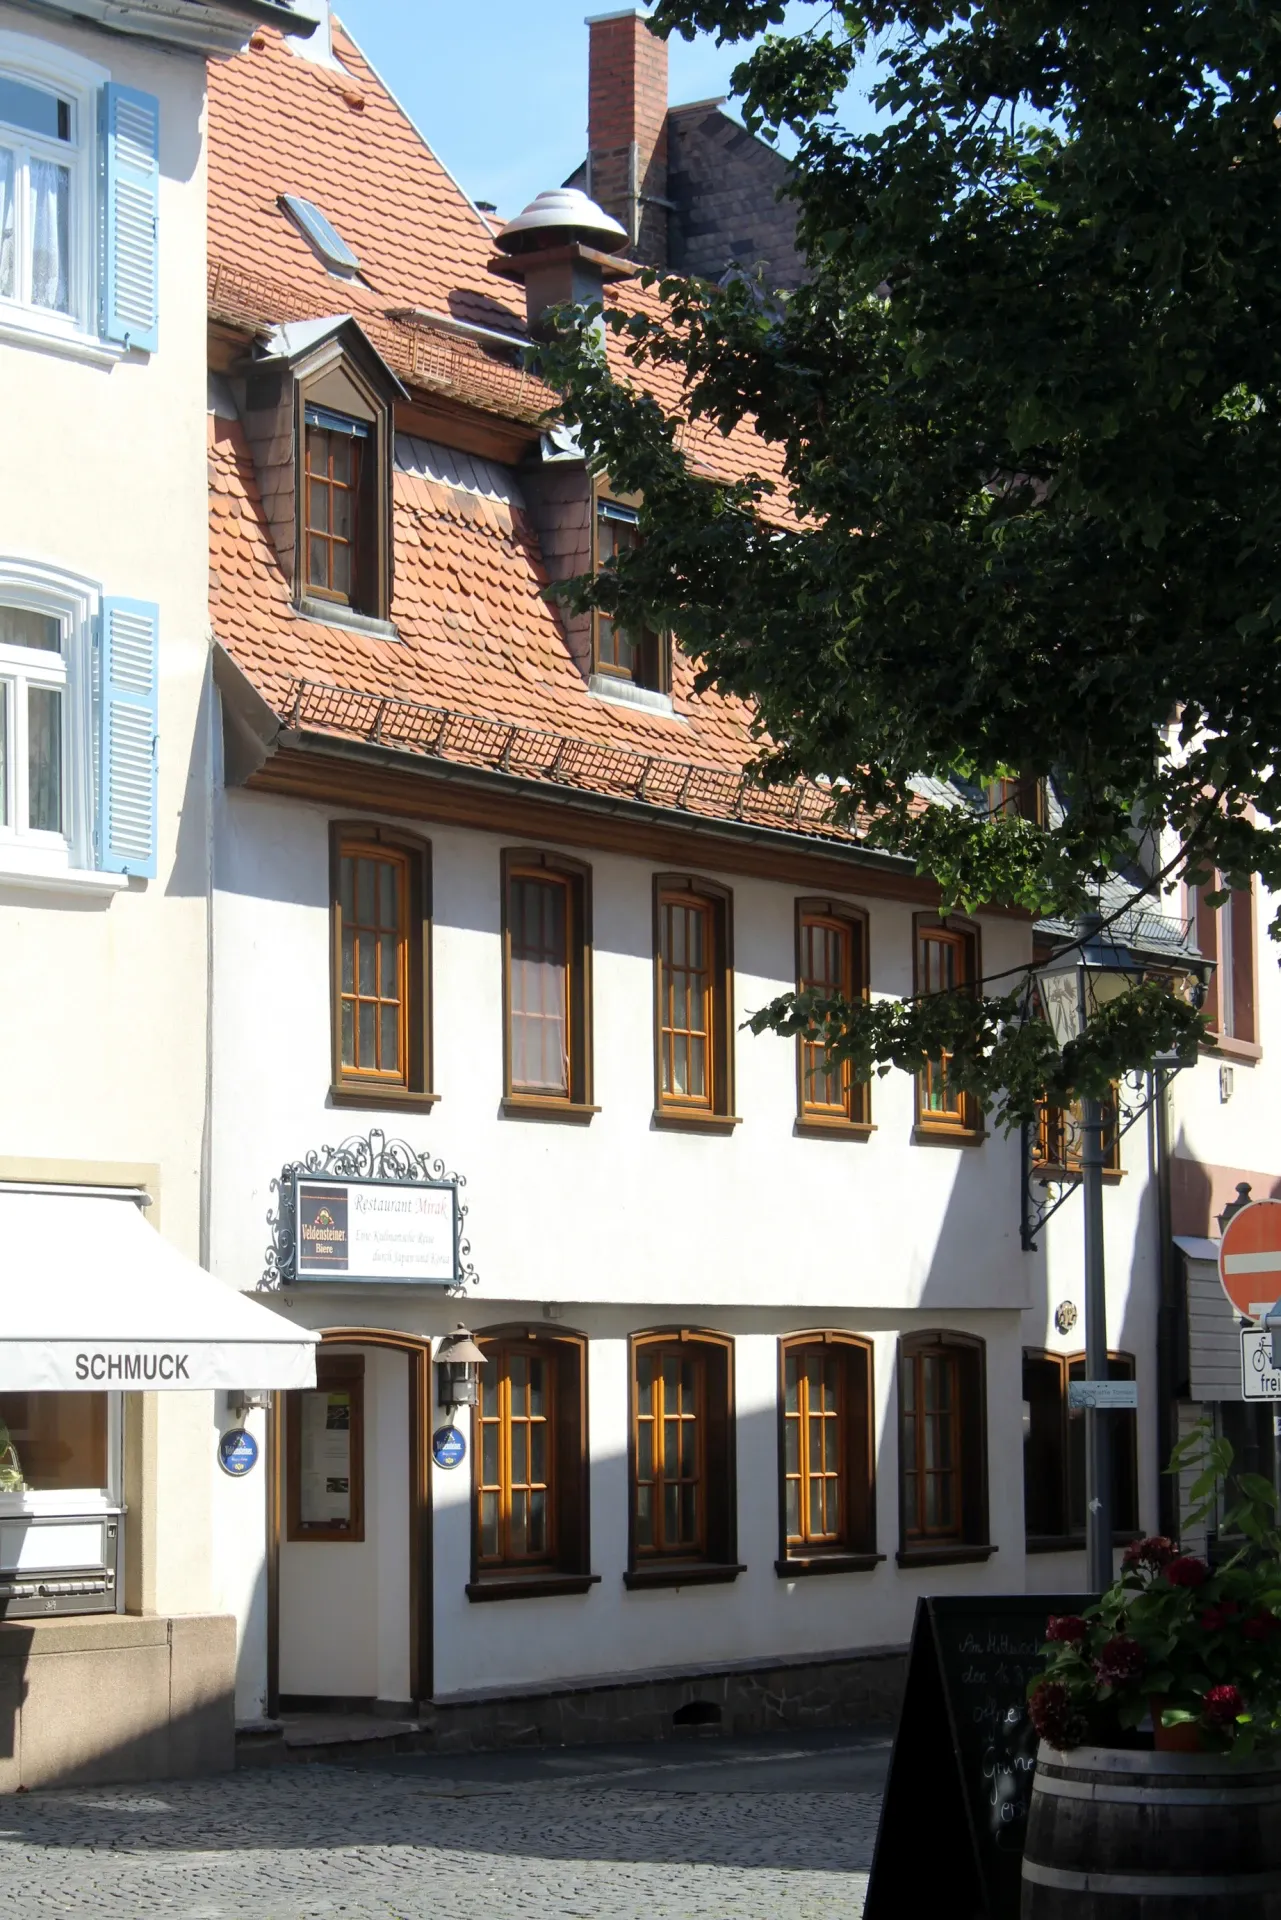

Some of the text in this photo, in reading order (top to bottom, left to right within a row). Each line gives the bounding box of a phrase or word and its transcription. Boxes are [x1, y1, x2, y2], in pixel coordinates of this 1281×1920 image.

[354, 1193, 412, 1215] Restaurant
[302, 1224, 346, 1241] Veldensteiner
[315, 1243, 334, 1254] Biere
[75, 1353, 190, 1380] SCHMUCK
[1260, 1373, 1281, 1392] frei
